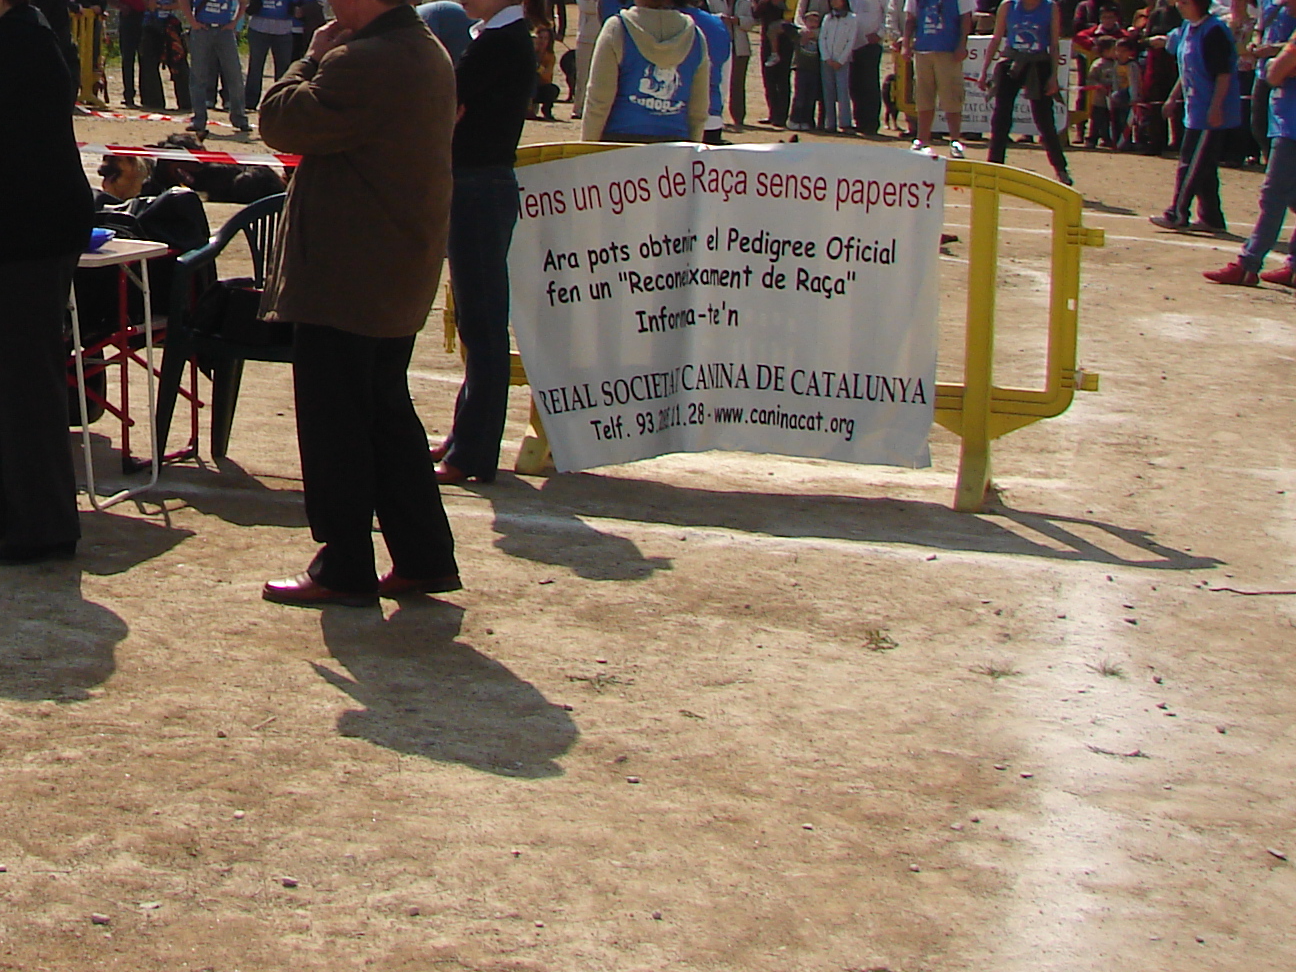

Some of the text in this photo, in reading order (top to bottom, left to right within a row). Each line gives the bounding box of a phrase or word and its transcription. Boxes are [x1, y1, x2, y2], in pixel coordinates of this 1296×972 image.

[572, 183, 602, 211] un
[609, 177, 651, 215] gos
[658, 166, 687, 199] de
[692, 160, 747, 202] Raça
[756, 172, 827, 201] sense
[836, 177, 935, 213] papers?
[543, 249, 580, 272] Ara
[587, 242, 630, 273] pots
[707, 227, 718, 251] el
[727, 228, 816, 263] Pedigree
[826, 236, 896, 264] Oficial
[546, 280, 581, 307] fen
[589, 280, 612, 300] un
[762, 265, 786, 289] de
[796, 267, 856, 299] Raça"
[538, 362, 926, 416] REIAL SOCIETAT CANINA DE CATALUNYA
[590, 414, 631, 441] Telf.
[714, 404, 855, 441] www.caninacat.org
